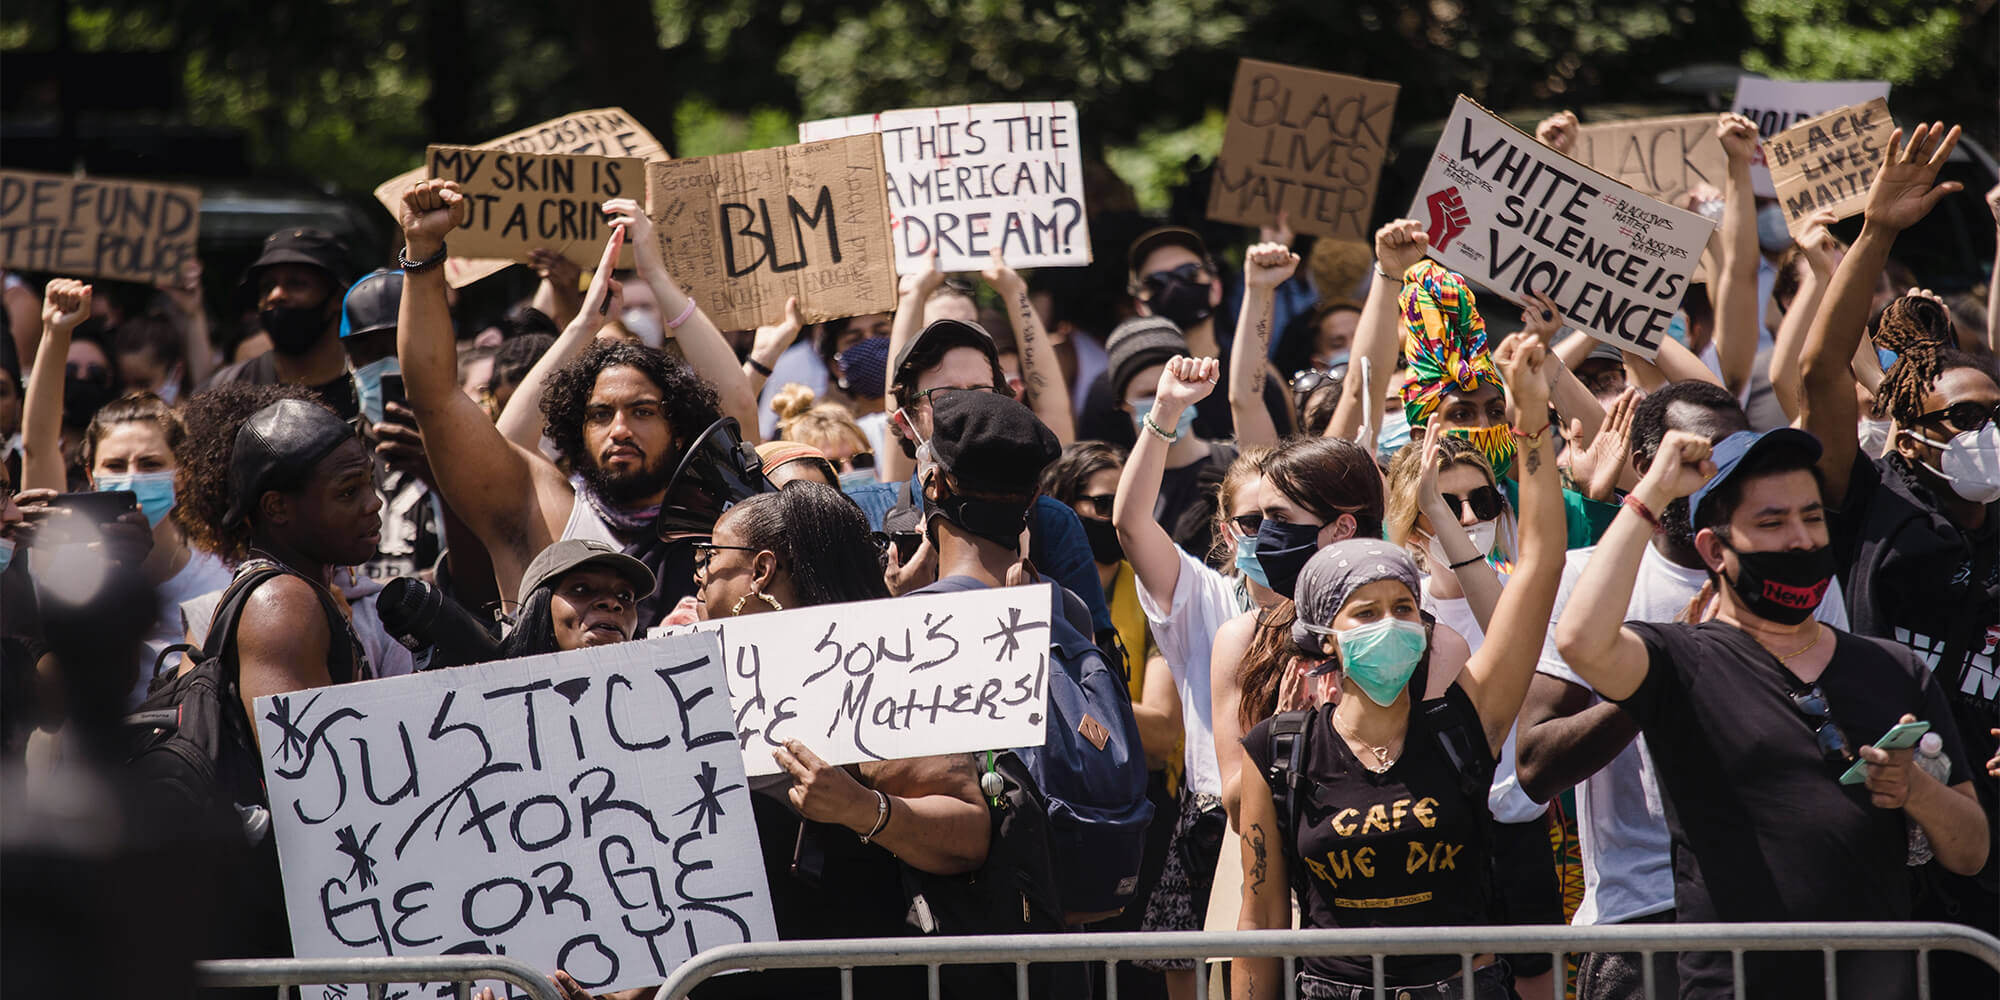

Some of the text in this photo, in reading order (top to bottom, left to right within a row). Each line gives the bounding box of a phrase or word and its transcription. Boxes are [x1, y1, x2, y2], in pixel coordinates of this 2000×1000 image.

[882, 115, 1069, 163] THIS THE
[1238, 72, 1391, 148] BLACK
[1774, 108, 1880, 167] BLACK
[433, 152, 622, 197] MY SKIN IS
[886, 161, 1067, 207] AMERICAN
[1259, 128, 1372, 186] LIVES
[1460, 116, 1602, 227] WHITE
[1801, 136, 1880, 182] LIVES
[0, 177, 195, 237] DEFUND
[1210, 160, 1370, 237] MATTER
[1786, 160, 1884, 220] MATTE
[0, 223, 89, 270] THE
[502, 202, 528, 241] A
[720, 185, 843, 277] BLM
[904, 198, 1081, 258] DREAM?
[1496, 195, 1685, 301] SILENCE IS
[1612, 210, 1651, 234] MATTER
[1489, 227, 1674, 352] VIOLENCE
[1766, 583, 1811, 607] New
[801, 612, 960, 688] SON'S
[274, 654, 738, 826] JUSTICE
[395, 766, 670, 860] FOR
[320, 832, 754, 957] GEORGE
[1304, 840, 1464, 889] RUE DIX
